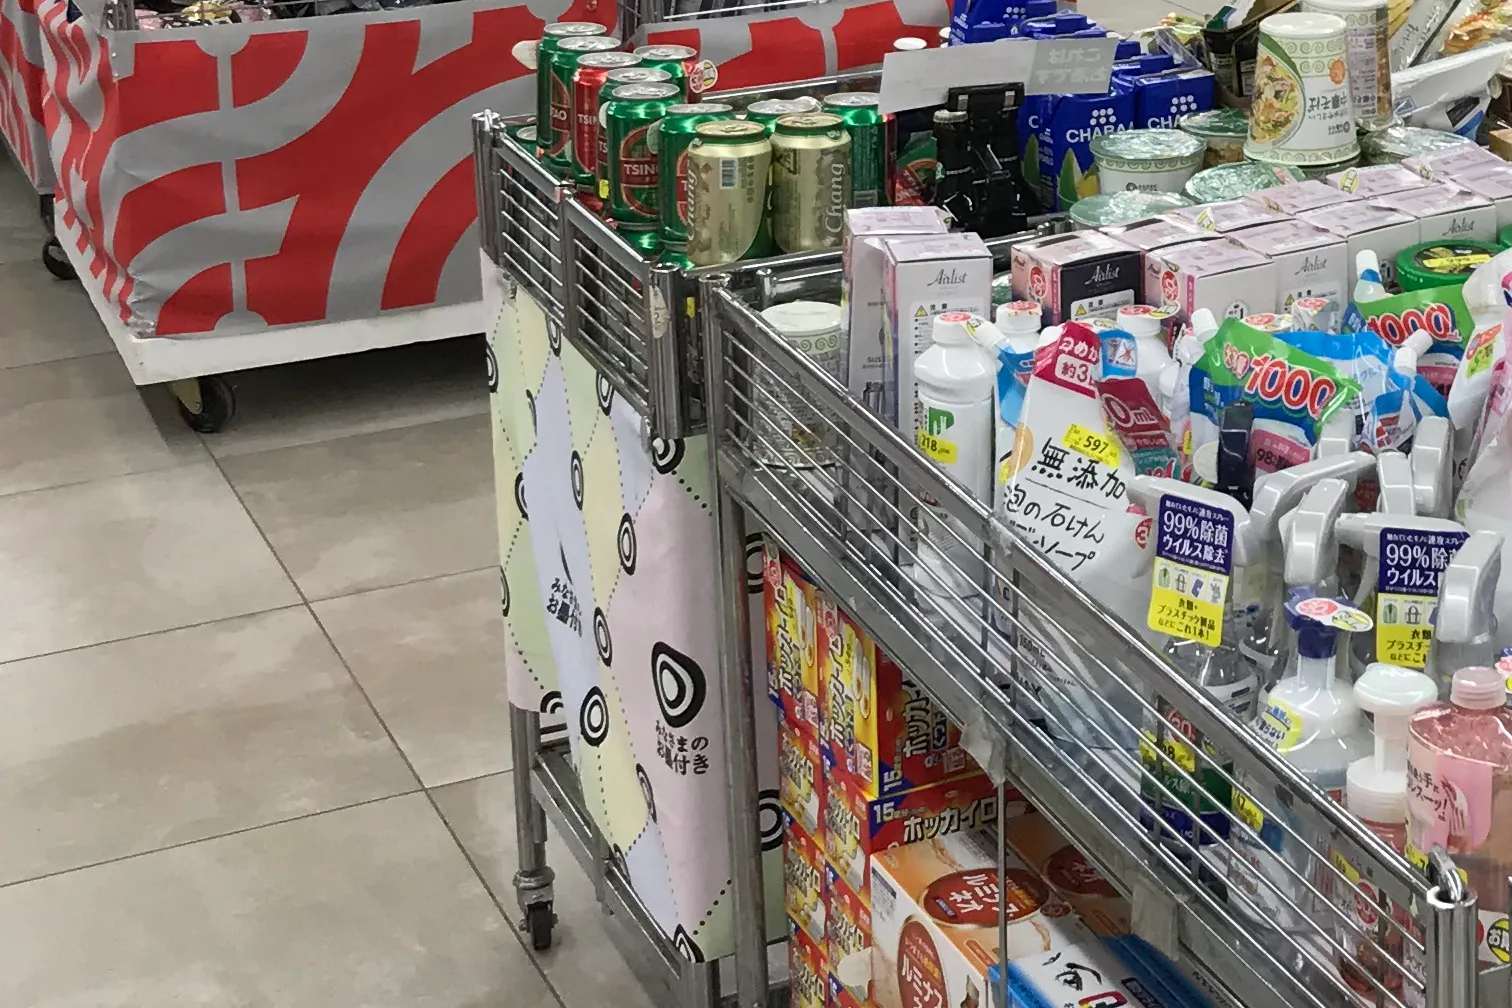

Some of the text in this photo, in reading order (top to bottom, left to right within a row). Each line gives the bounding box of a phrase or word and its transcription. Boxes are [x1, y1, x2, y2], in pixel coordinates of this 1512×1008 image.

[825, 160, 846, 236] Chang
[926, 267, 967, 287] Airlist
[1084, 264, 1120, 284] Airlist
[1294, 255, 1328, 275] Airlist
[1366, 302, 1453, 346] 1000
[1246, 355, 1336, 420] 1000
[1083, 434, 1109, 455] 597
[1031, 437, 1127, 500] 無添加
[1004, 482, 1105, 544] 泡の石けん
[1163, 510, 1229, 547] 99%除菌
[1163, 535, 1228, 565] ウイルス除去
[1387, 569, 1442, 587] ウイルス
[1157, 603, 1216, 631] プラスチック製品
[872, 796, 999, 843] 15 ホッカイロ
